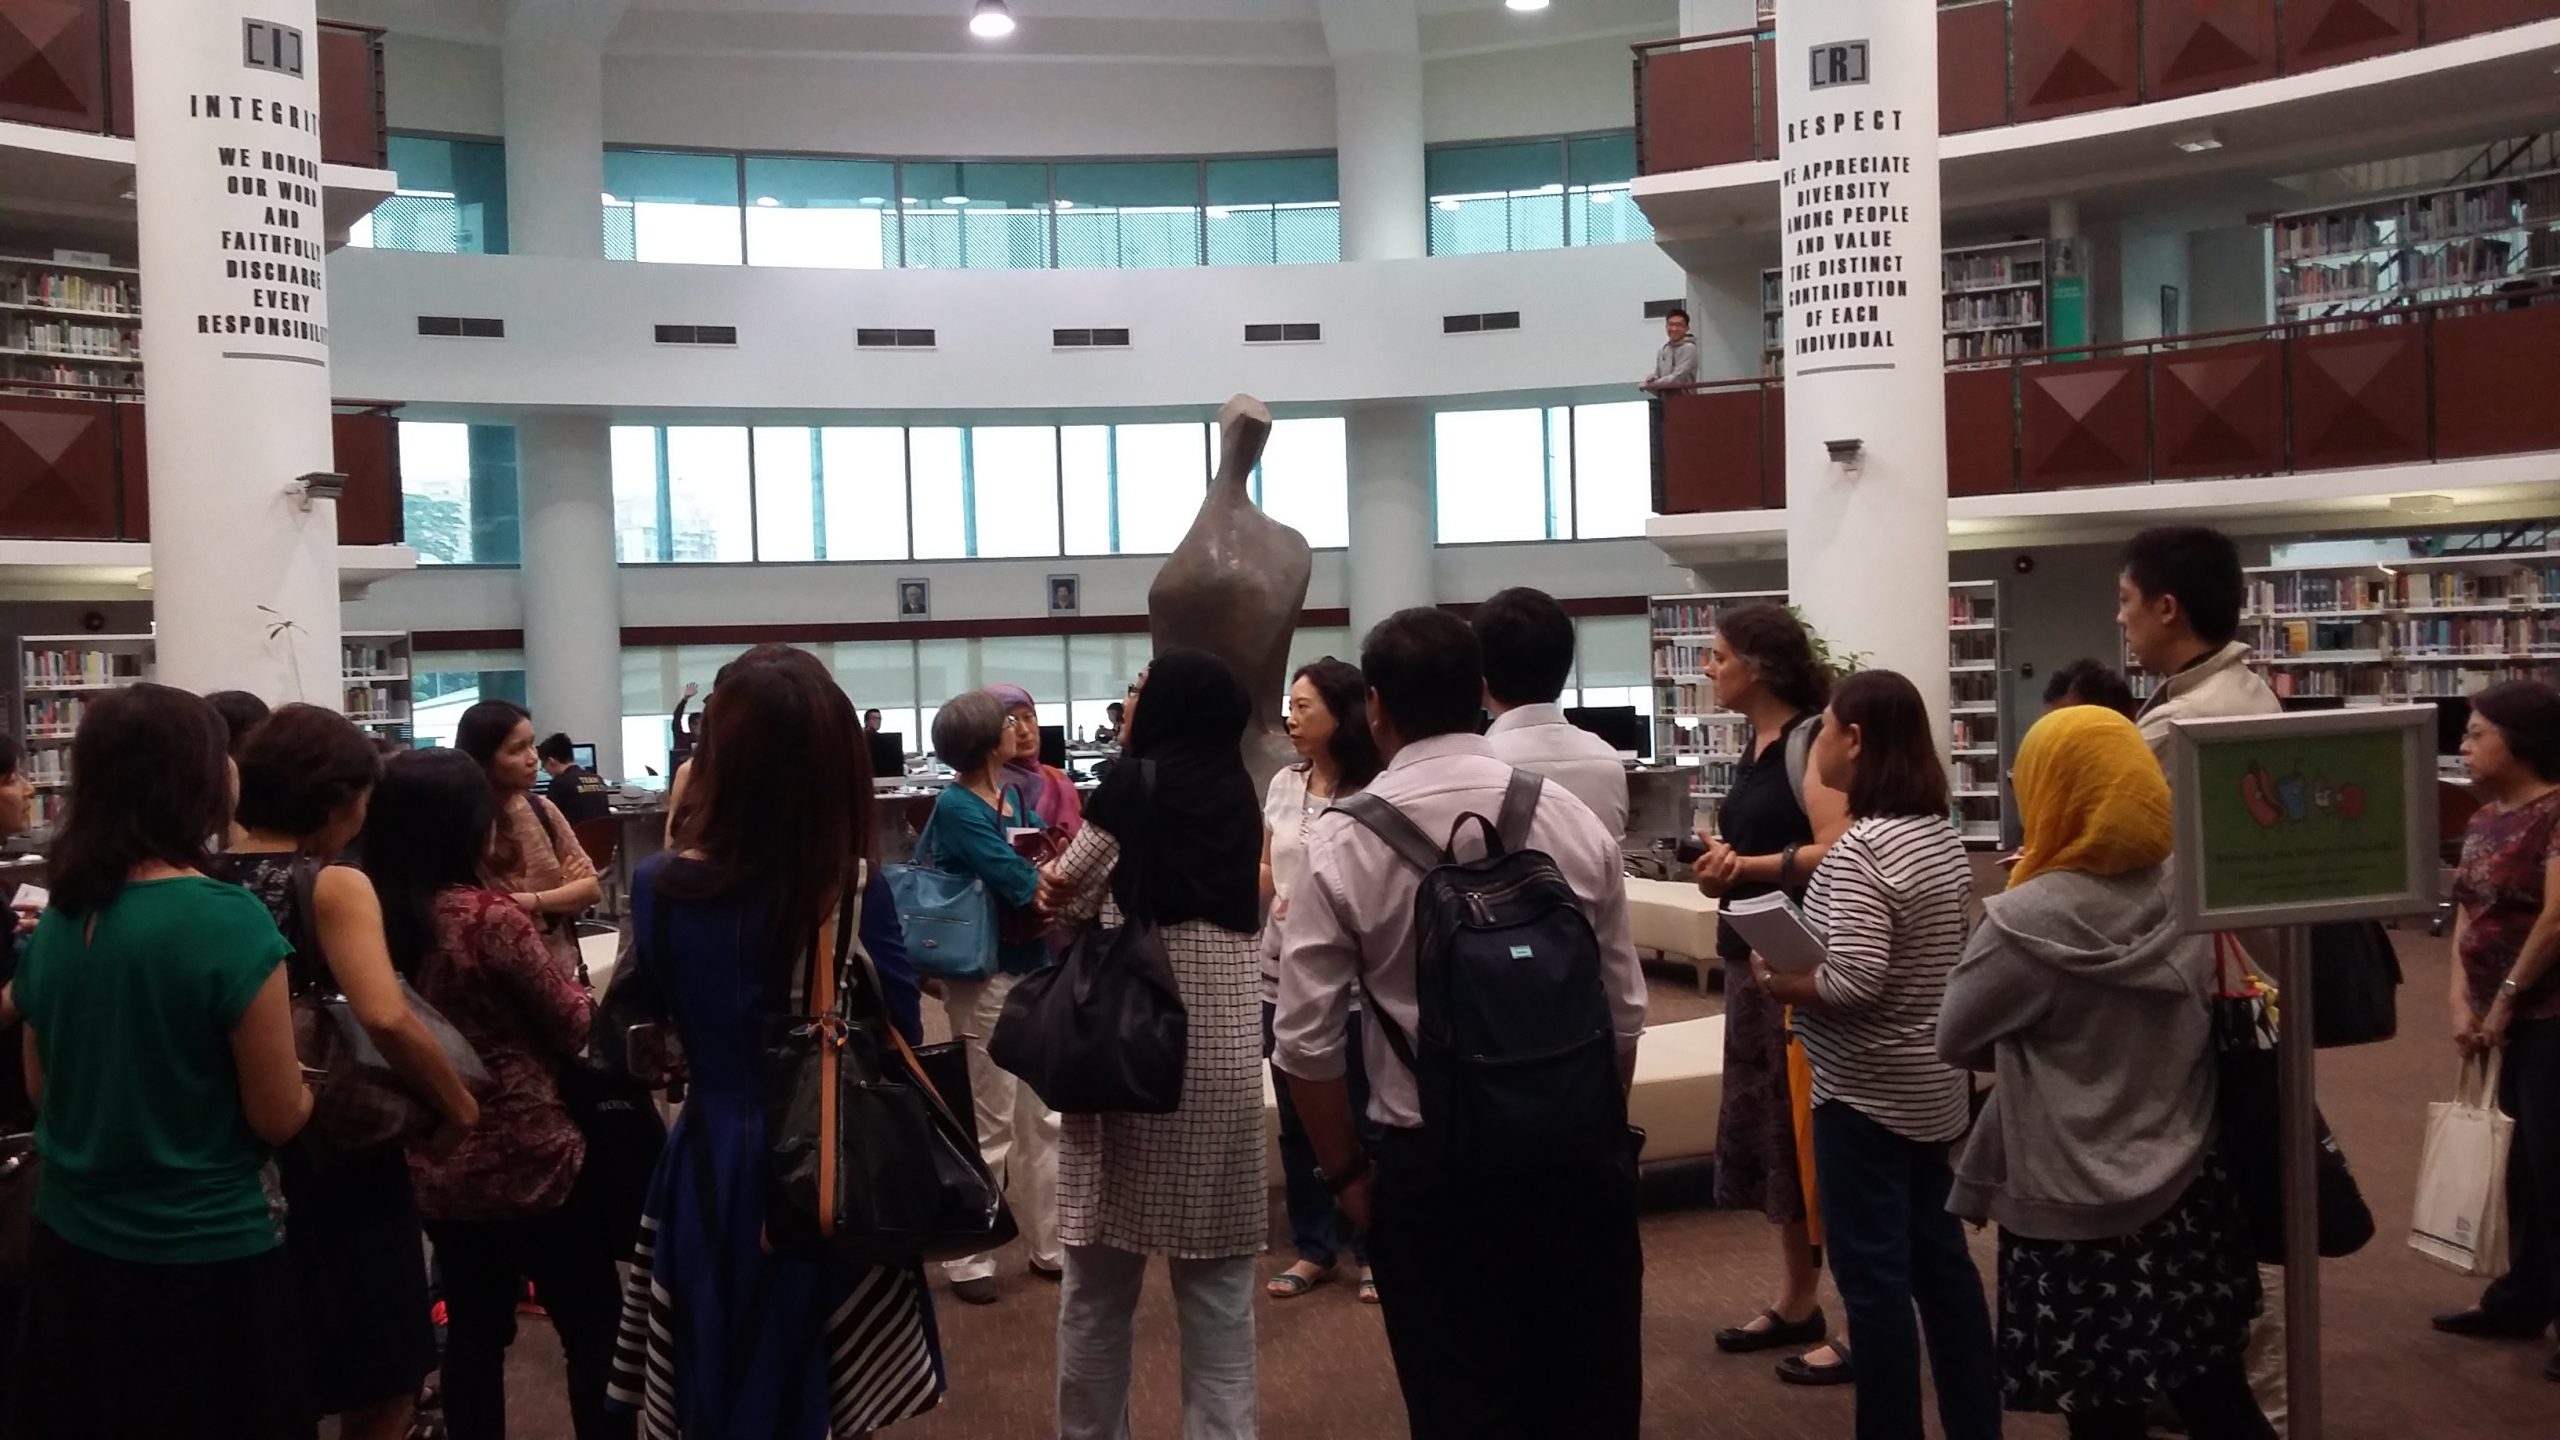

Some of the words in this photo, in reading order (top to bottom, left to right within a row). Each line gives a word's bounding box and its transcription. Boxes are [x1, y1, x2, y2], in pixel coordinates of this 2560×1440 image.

[190, 95, 317, 137] INTEGRIT
[1788, 110, 1902, 144] RESPECT
[219, 147, 250, 167] WE
[1803, 156, 1911, 181] APPRECIATE
[227, 176, 267, 198] OUR
[1797, 181, 1890, 207] DIVERSITY
[264, 207, 299, 229] AND
[1788, 210, 1833, 234] AMONG
[1844, 206, 1909, 224] PEOPLE
[222, 231, 321, 262] FAITHFULLY
[1797, 239, 1825, 256] AND
[1835, 230, 1893, 249] VALUE
[227, 260, 321, 290] DISCHARGE
[1790, 261, 1811, 283] THE
[1819, 255, 1903, 277] DISTINCT
[254, 289, 310, 313] EVERY
[1789, 279, 1908, 308] CONTRIBUTION
[1806, 309, 1823, 327] OF
[1832, 305, 1879, 325] EACH
[1796, 330, 1894, 355] INDIVIDUAL
